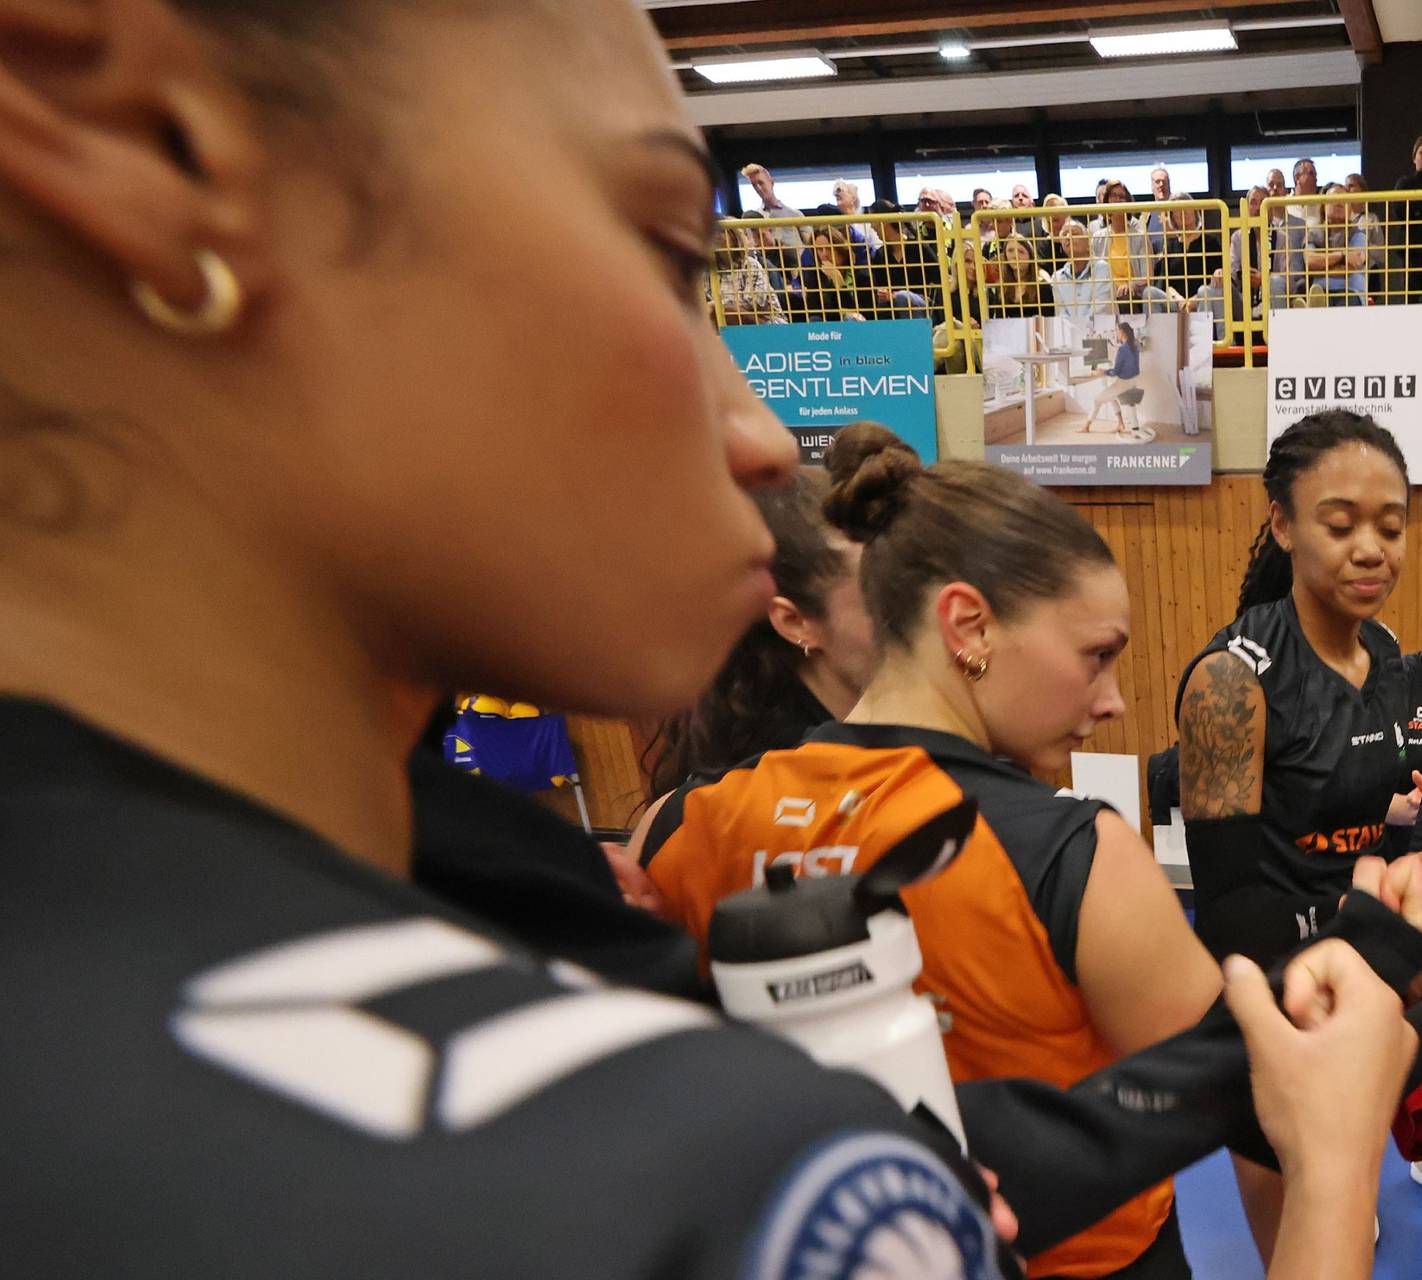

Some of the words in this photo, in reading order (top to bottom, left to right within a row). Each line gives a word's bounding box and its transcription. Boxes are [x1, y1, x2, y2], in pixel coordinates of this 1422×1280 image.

[808, 331, 829, 341] Mode
[831, 331, 842, 340] für
[731, 351, 832, 373] LADIES
[839, 357, 850, 366] in
[856, 355, 891, 366] black
[747, 374, 929, 399] GENTLEMEN
[799, 408, 810, 416] für
[811, 408, 832, 418] jeden
[834, 407, 858, 416] Anlass
[1001, 454, 1020, 464] Deine
[1021, 453, 1058, 464] Arbeitswelt
[1060, 453, 1071, 463] für
[1072, 454, 1097, 465] morgen
[1107, 456, 1177, 469] FRANKENNE
[1024, 464, 1035, 475] auf
